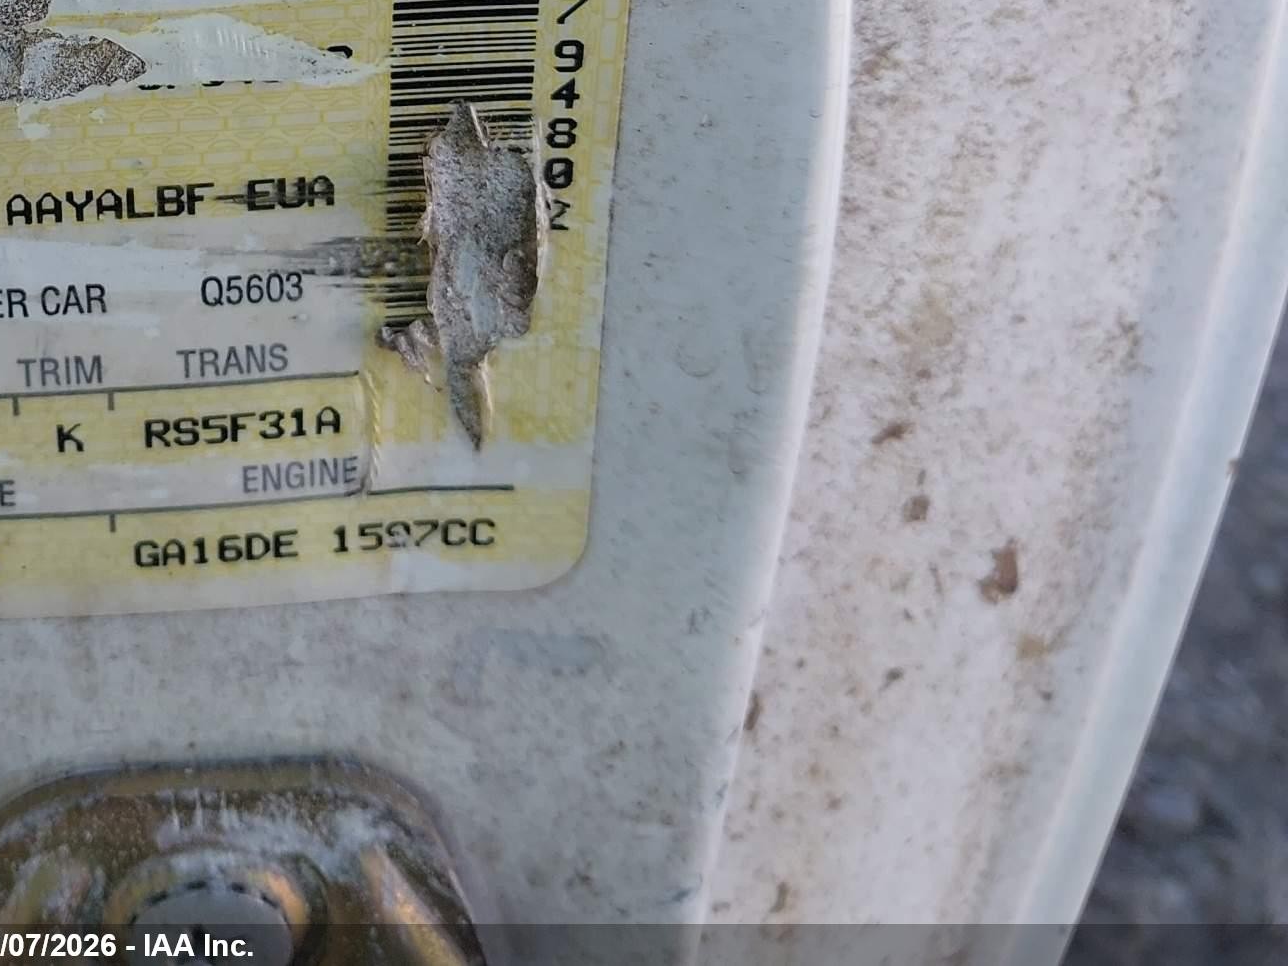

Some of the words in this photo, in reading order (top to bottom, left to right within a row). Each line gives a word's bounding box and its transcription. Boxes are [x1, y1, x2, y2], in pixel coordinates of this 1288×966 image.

[41, 283, 107, 316] CAR
[201, 272, 303, 307] Q5603
[17, 354, 103, 387] TRIM
[176, 343, 289, 379] TRANS
[56, 423, 84, 453] K
[144, 406, 341, 448] RS5F31A
[242, 455, 359, 494] ENGINE
[133, 529, 299, 567] GA16DE
